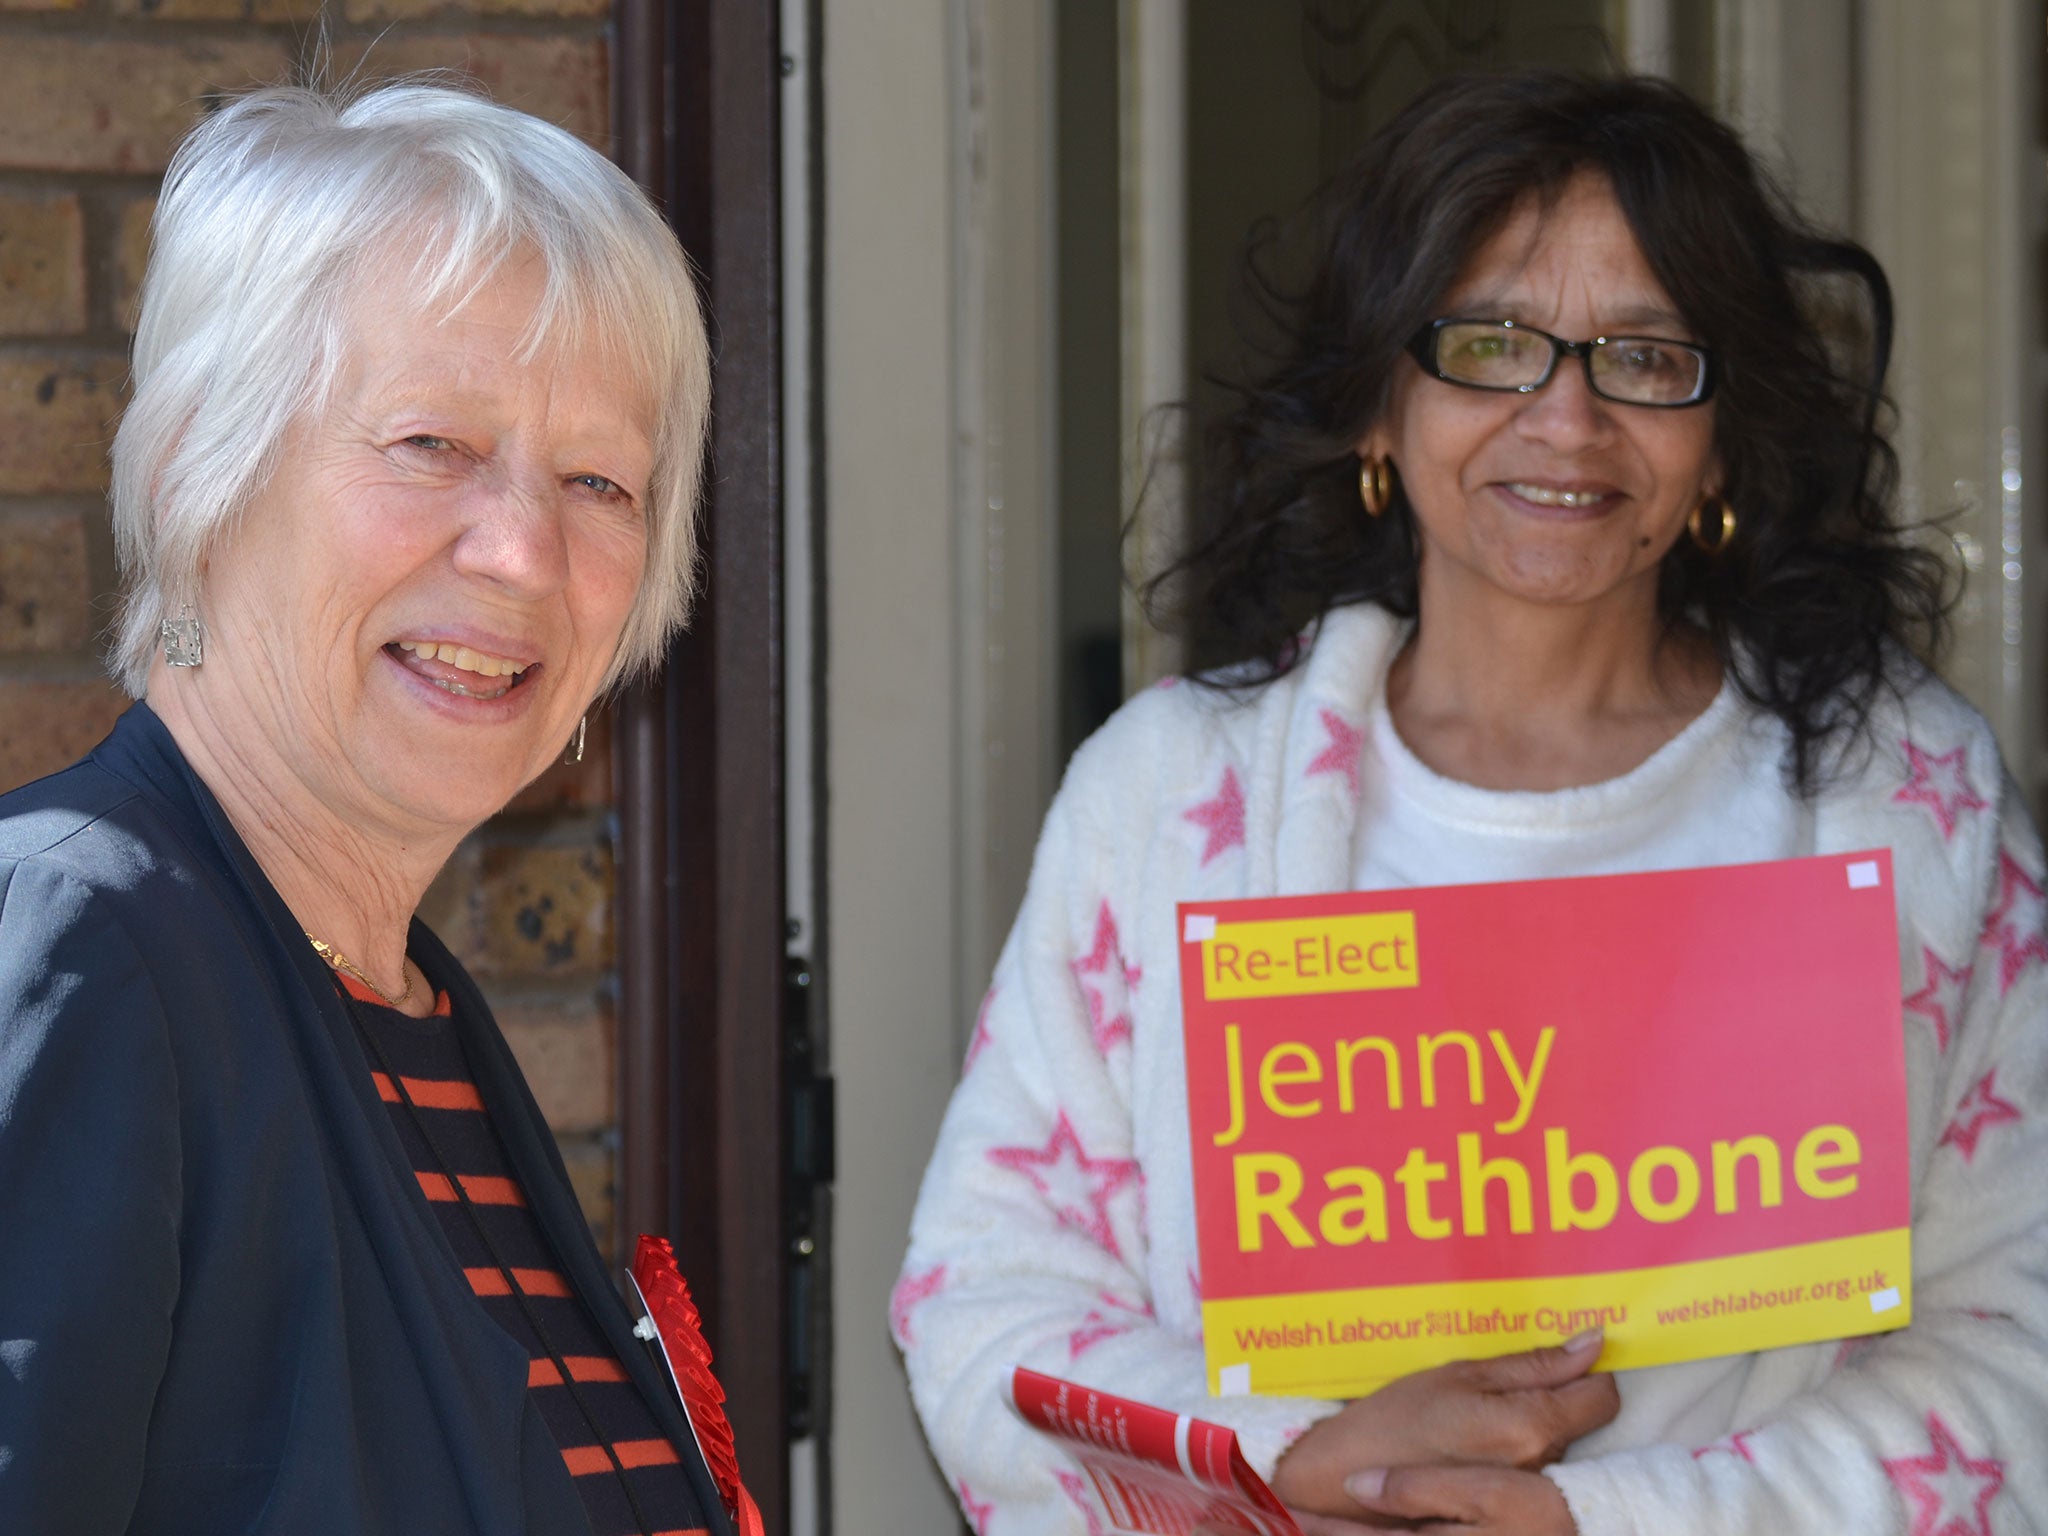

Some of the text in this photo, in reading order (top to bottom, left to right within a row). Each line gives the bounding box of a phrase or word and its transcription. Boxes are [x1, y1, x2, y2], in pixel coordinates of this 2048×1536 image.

[1213, 934, 1409, 983] Re-Elect
[1213, 1025, 1556, 1147] Jenny
[1233, 1125, 1862, 1252] Rathbone
[1656, 1269, 1889, 1326] welshlabour.org.uk
[1234, 1303, 1629, 1352] Welsh Labour Llafur Cymru
